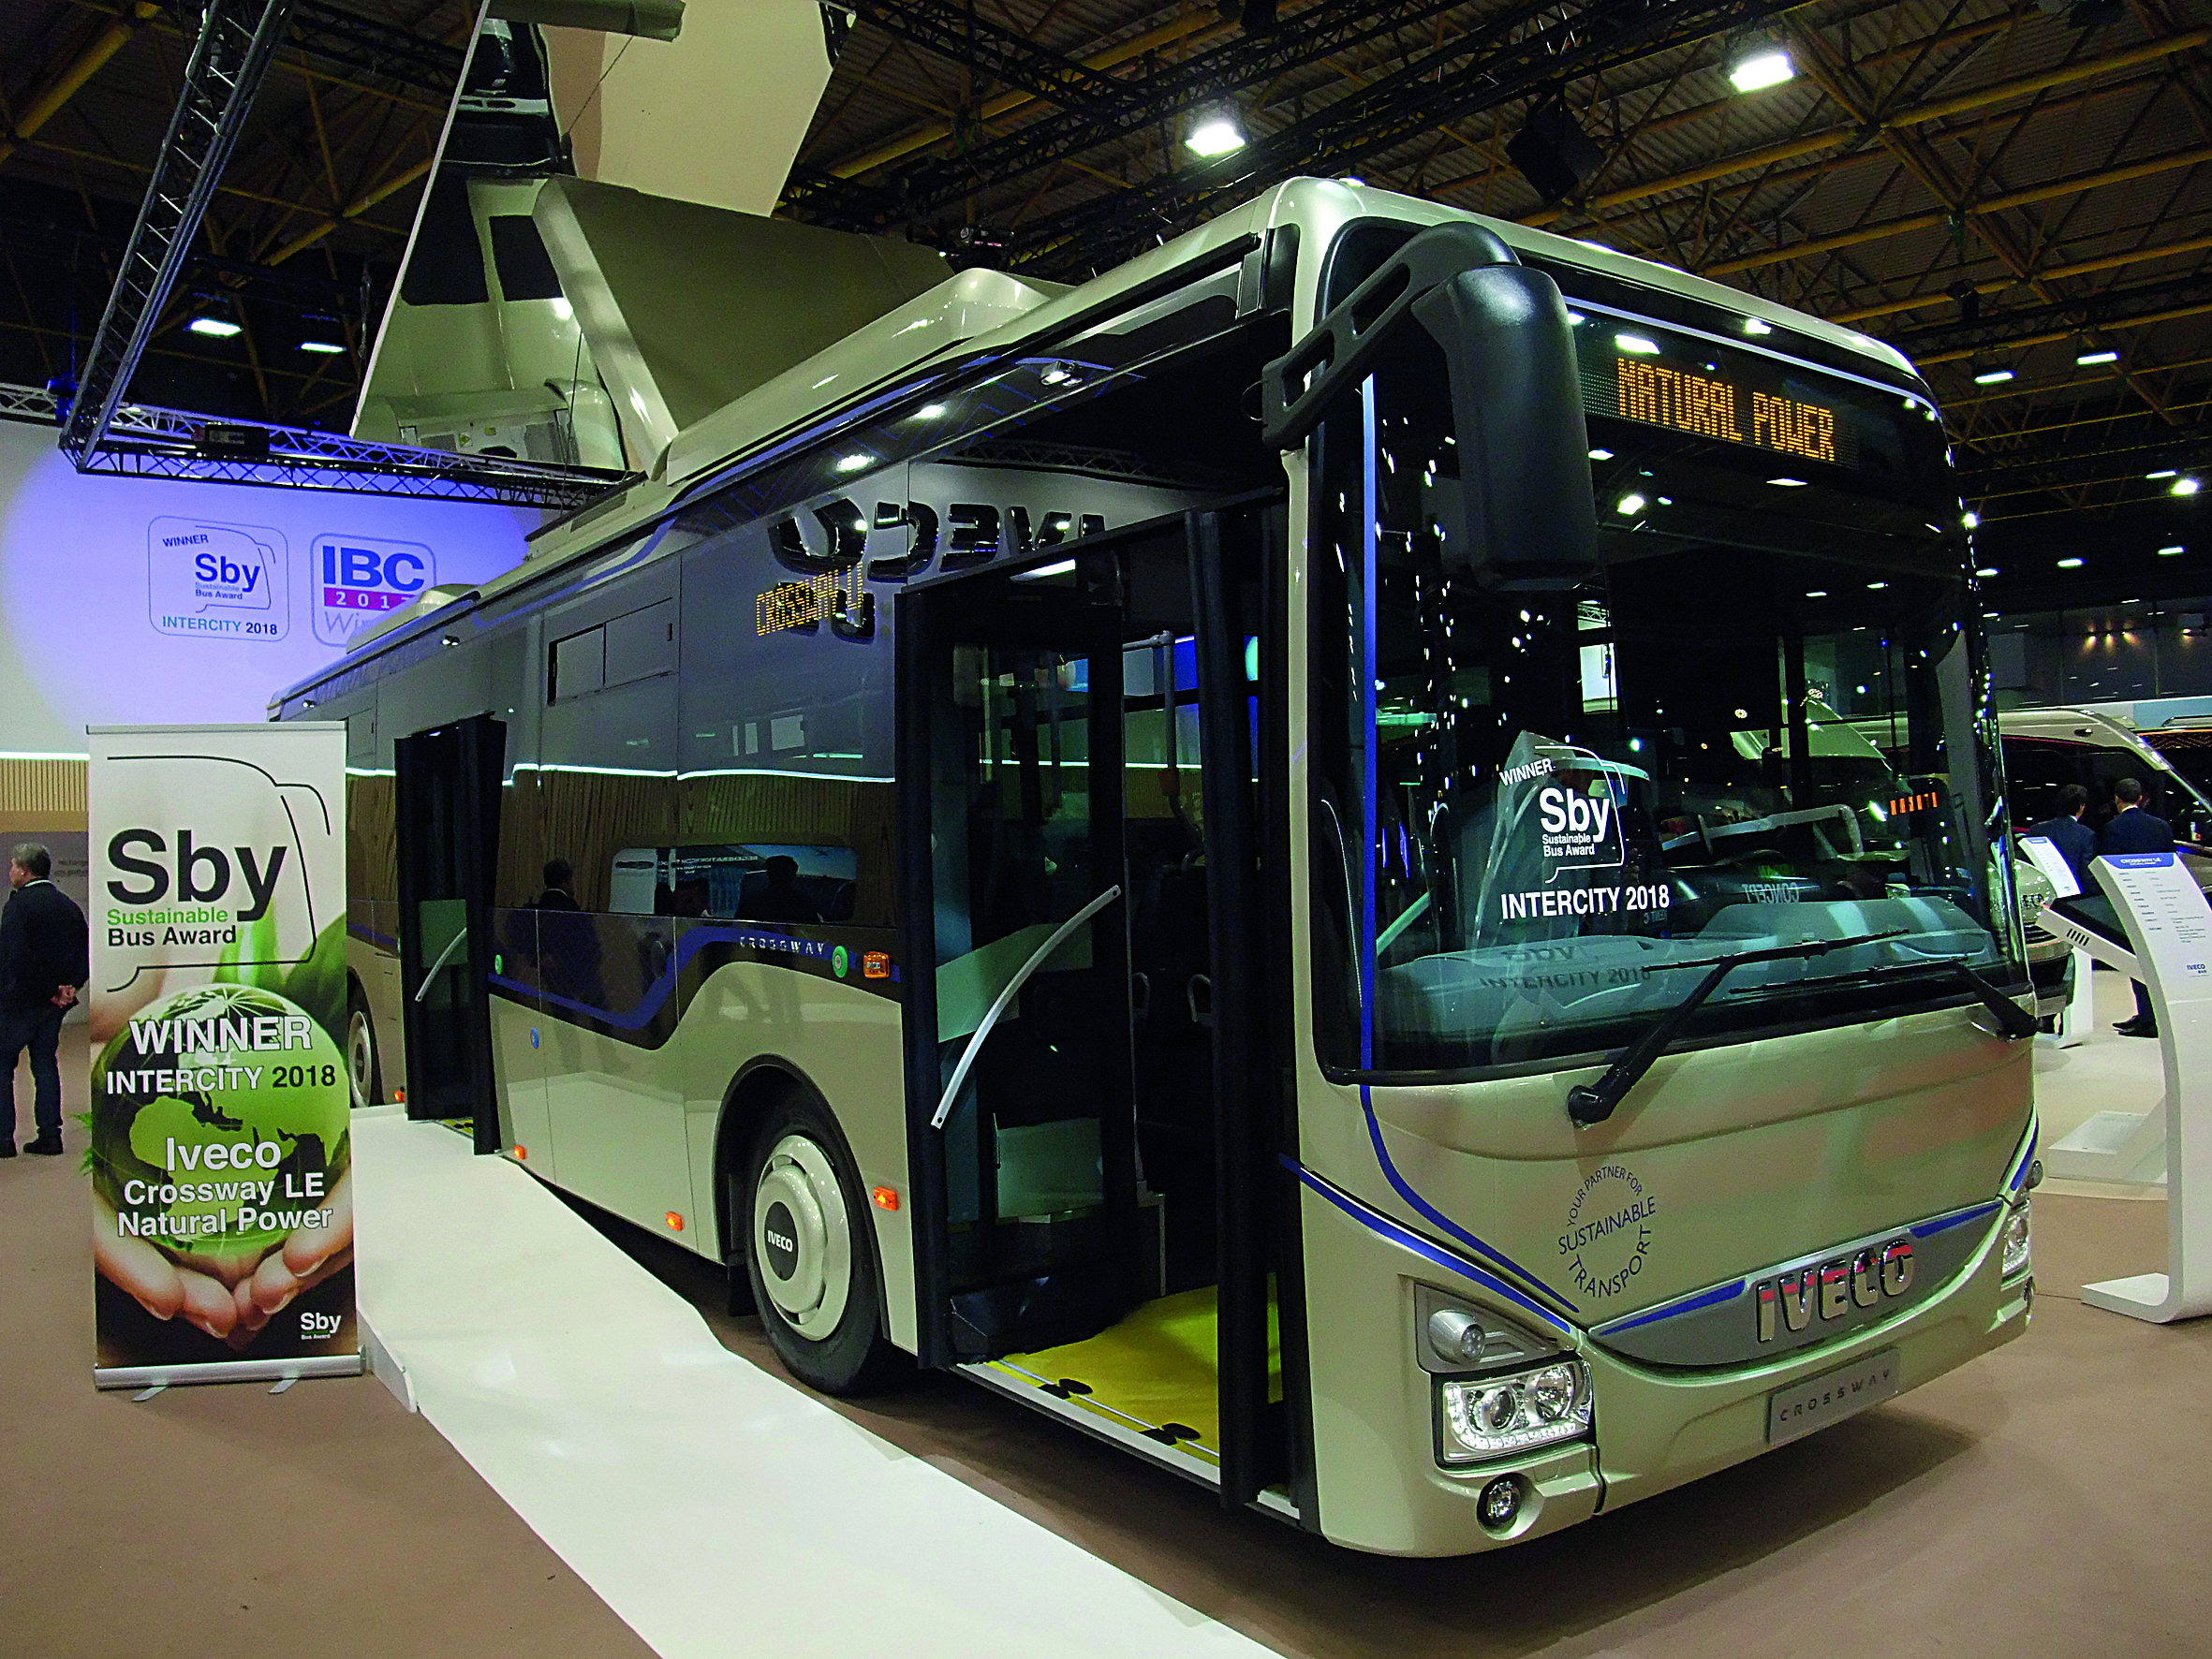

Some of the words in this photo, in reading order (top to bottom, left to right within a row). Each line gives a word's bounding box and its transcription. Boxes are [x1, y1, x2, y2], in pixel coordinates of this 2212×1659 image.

[1617, 358, 1743, 442] NATURAL
[1753, 391, 1835, 462] POWER
[162, 534, 209, 548] WINNER
[195, 552, 260, 593] Sby
[322, 545, 424, 592] IBC
[195, 581, 240, 592] Sustainable
[195, 590, 214, 598] Bus
[214, 591, 243, 600] Award
[335, 591, 409, 609] 201
[162, 615, 242, 632] INTERCITY
[245, 622, 278, 635] 2018
[1499, 757, 1554, 786] WINNER
[1539, 787, 1610, 844] Sby
[1541, 833, 1592, 845] Sustainable
[1543, 845, 1564, 858] Bus
[1565, 844, 1596, 857] Award
[106, 828, 288, 923] Sby
[106, 906, 229, 926] Sustainable
[1500, 887, 1621, 919] INTERCITY
[1626, 885, 1670, 911] 2018
[108, 928, 155, 947] Bus
[161, 925, 237, 946] Award
[129, 1015, 313, 1055] WINNER
[107, 1066, 263, 1094] INTERCITY
[272, 1064, 336, 1088] 2018
[166, 1137, 282, 1172] Iveco
[124, 1179, 275, 1207] Crossway
[285, 1172, 325, 1198] LE
[1567, 1188, 1586, 1227] YOUR
[1584, 1166, 1627, 1191] PARTNER
[1627, 1172, 1643, 1197] FOR
[118, 1208, 227, 1238] Natural
[238, 1208, 333, 1234] Power
[1558, 1196, 1656, 1255] SUSTAINABLE
[768, 1229, 793, 1253] IVECO
[1568, 1225, 1651, 1298] TRANSPORT
[1756, 1239, 1914, 1343] IVECO
[300, 1312, 342, 1334] Sby
[1779, 1368, 1891, 1422] CROSSWAY
